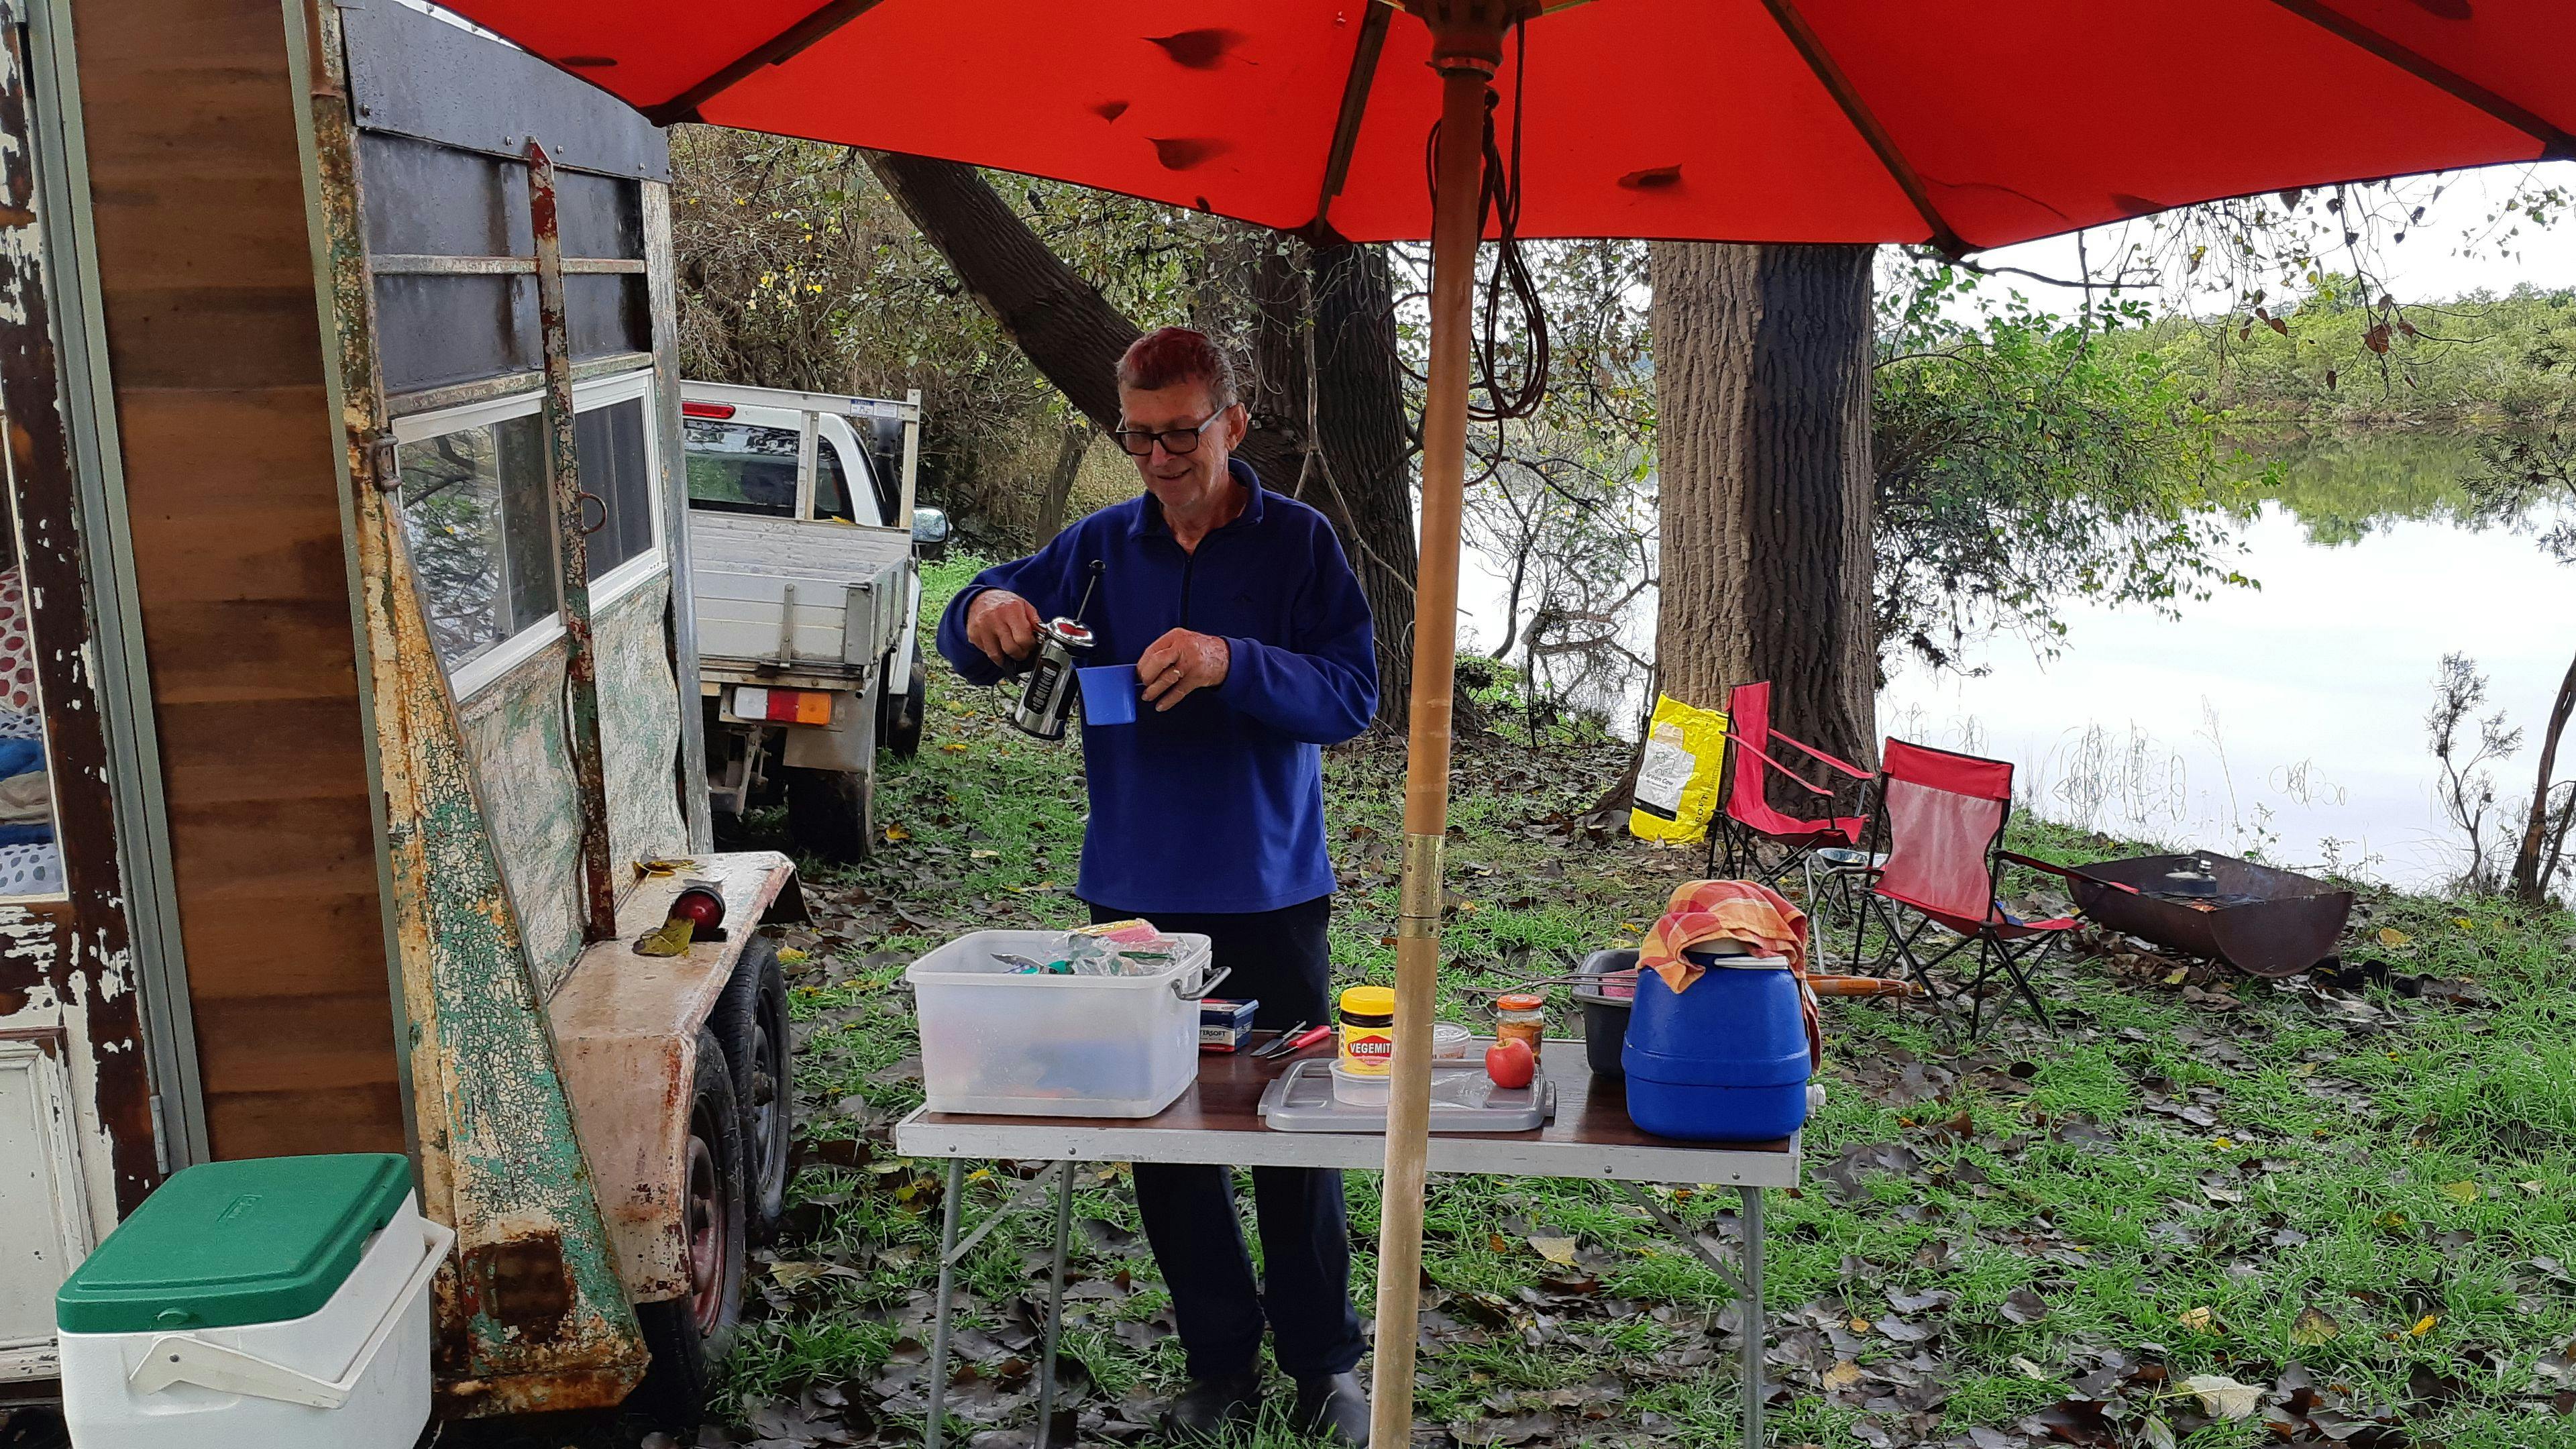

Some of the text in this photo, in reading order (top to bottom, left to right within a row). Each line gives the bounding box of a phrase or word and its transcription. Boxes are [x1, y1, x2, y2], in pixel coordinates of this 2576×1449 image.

[1646, 772, 1662, 782] Green
[1695, 794, 1708, 823] SOFT
[1350, 1042, 1391, 1054] VEGEMIT
